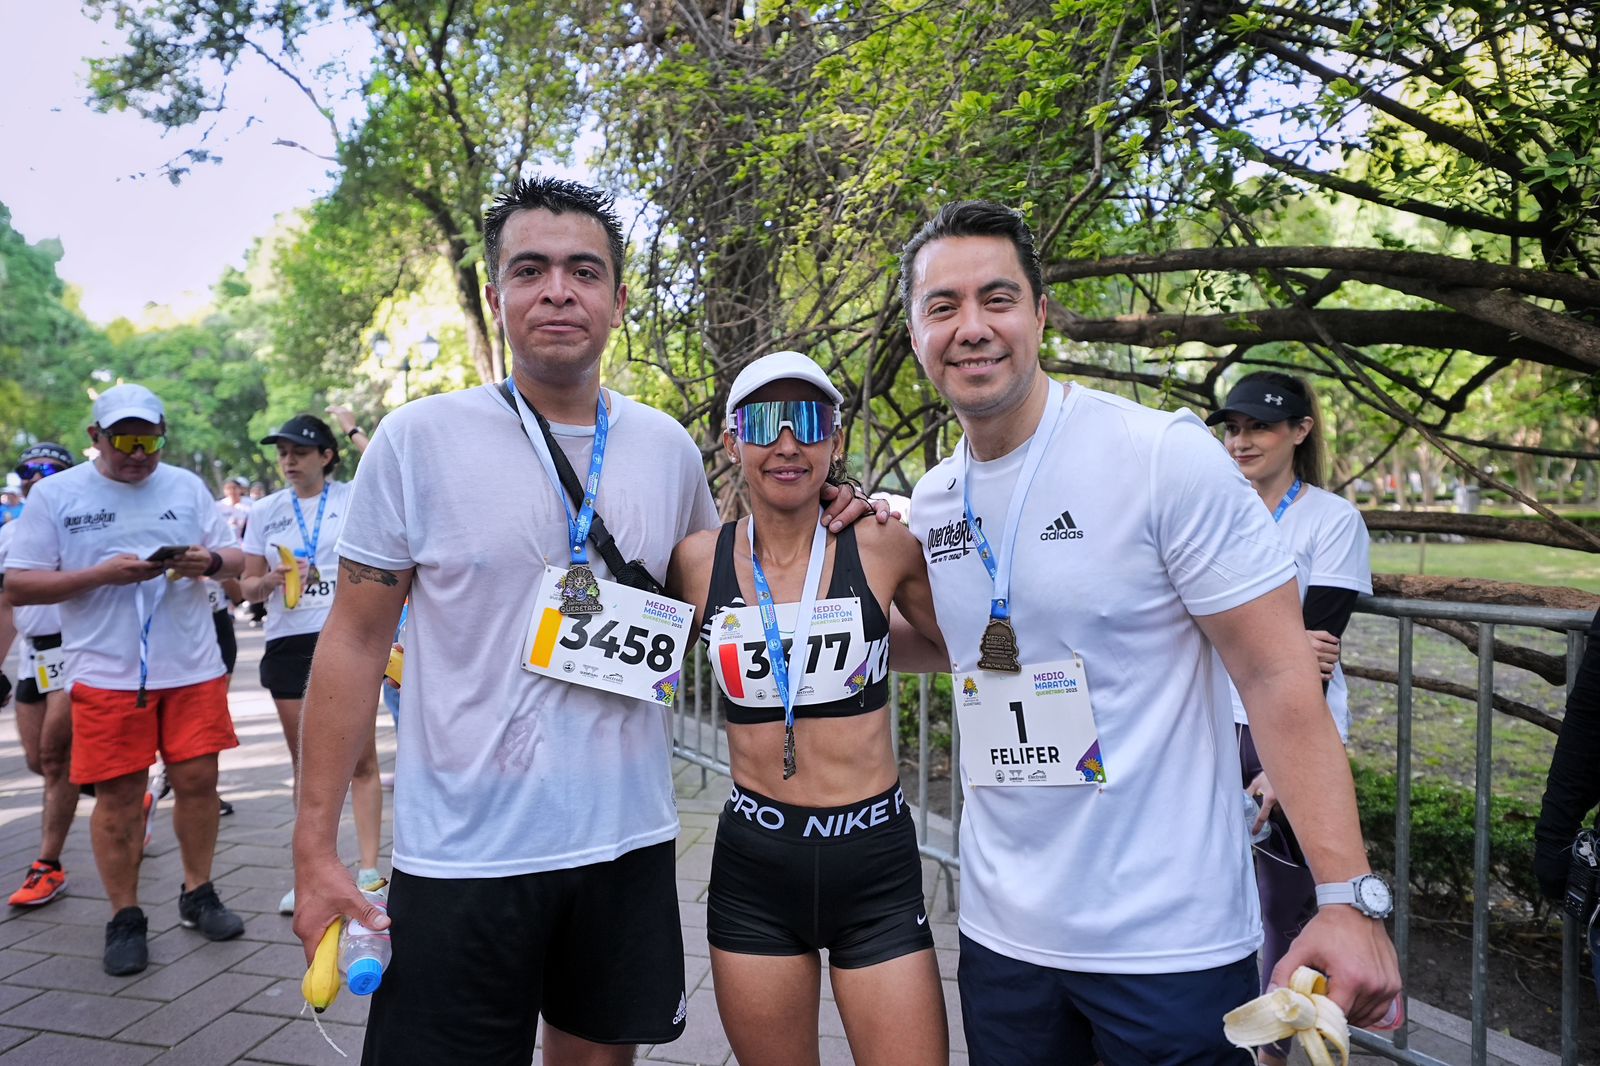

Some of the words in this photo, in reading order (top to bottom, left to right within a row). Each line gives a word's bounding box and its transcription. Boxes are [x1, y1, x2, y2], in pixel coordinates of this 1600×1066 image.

[1040, 529, 1084, 540] adidas
[645, 600, 677, 614] MEDIO
[559, 613, 676, 673] 3458
[1033, 671, 1065, 682] MEDIO
[1009, 701, 1028, 743] 1
[990, 746, 1061, 765] FELIFER
[802, 798, 889, 838] NIKE
